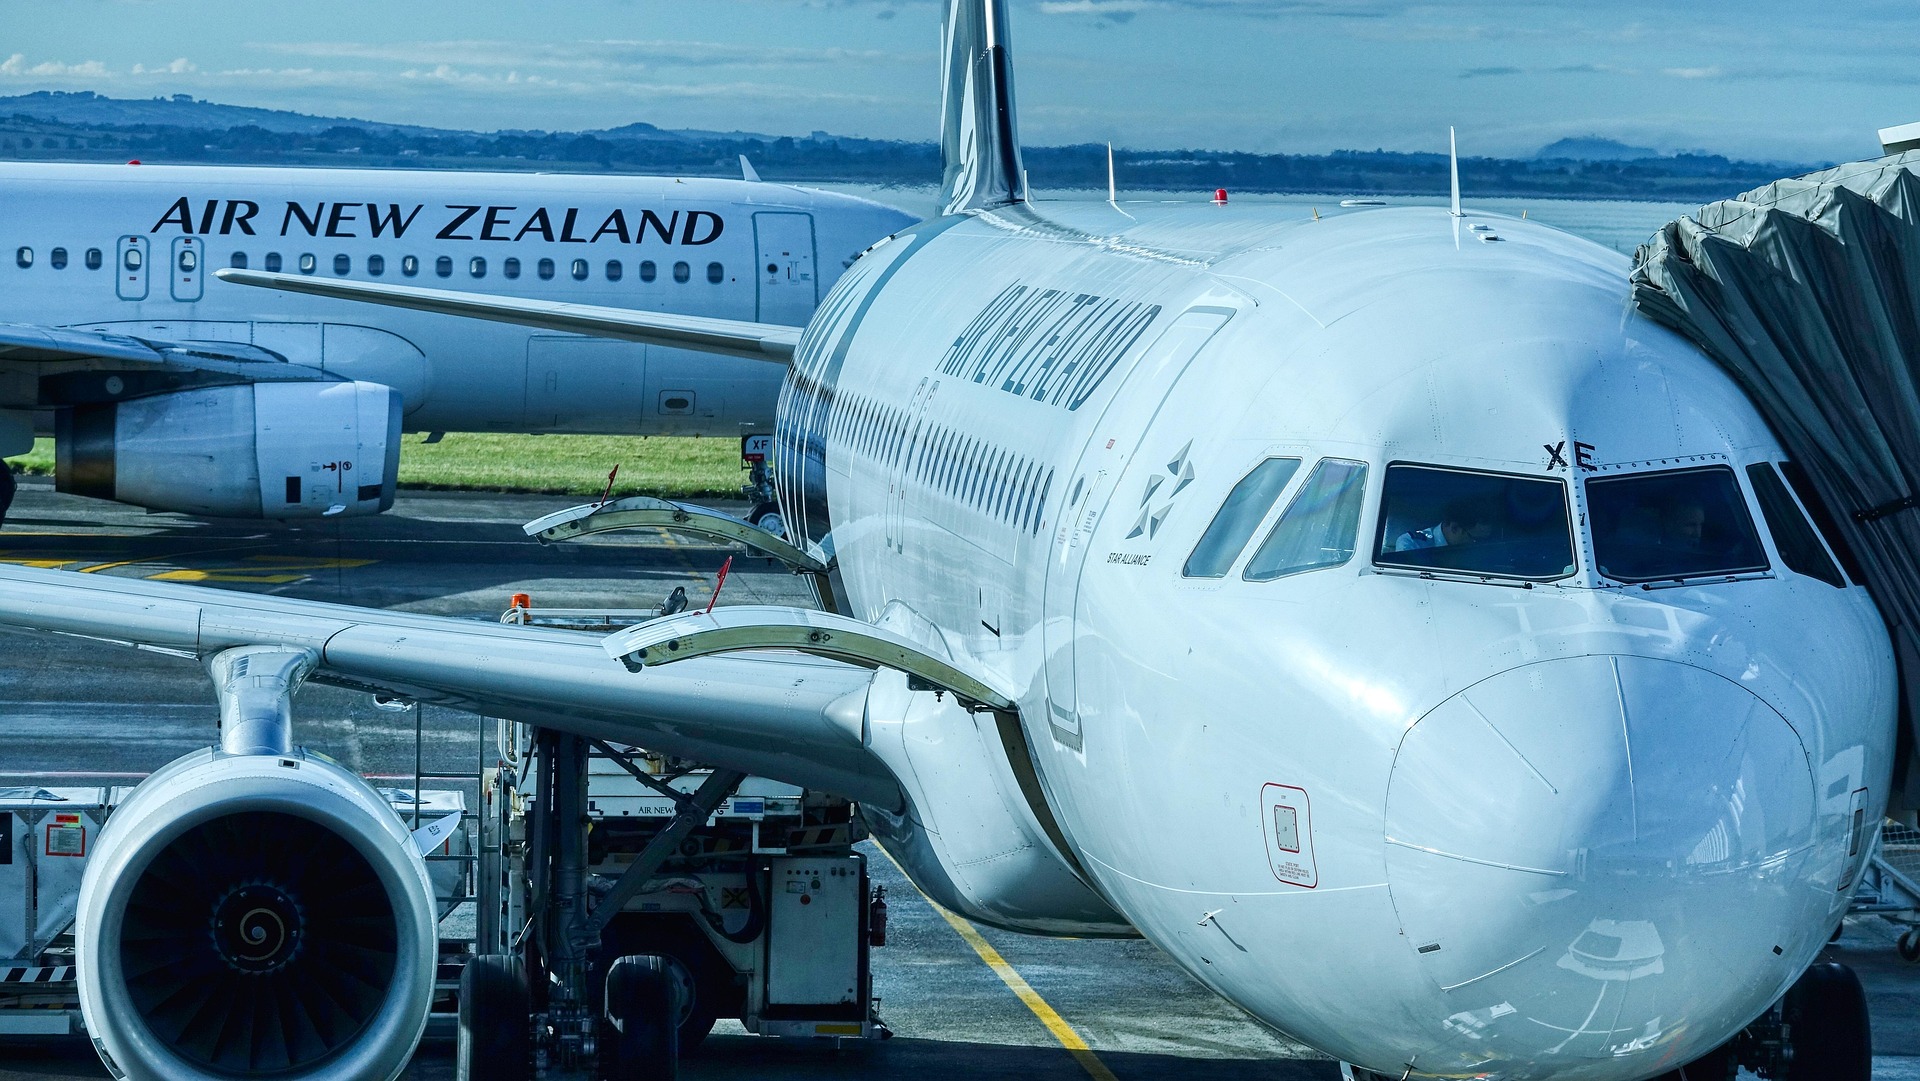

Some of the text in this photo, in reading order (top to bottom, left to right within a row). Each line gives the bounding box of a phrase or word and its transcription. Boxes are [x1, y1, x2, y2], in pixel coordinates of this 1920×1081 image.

[150, 196, 724, 246] AIR NEW ZEALAND
[753, 439, 769, 449] XF
[1543, 440, 1598, 472] XE
[1107, 552, 1152, 566] STAR ALLIANCE
[638, 806, 674, 815] AIR NEW
